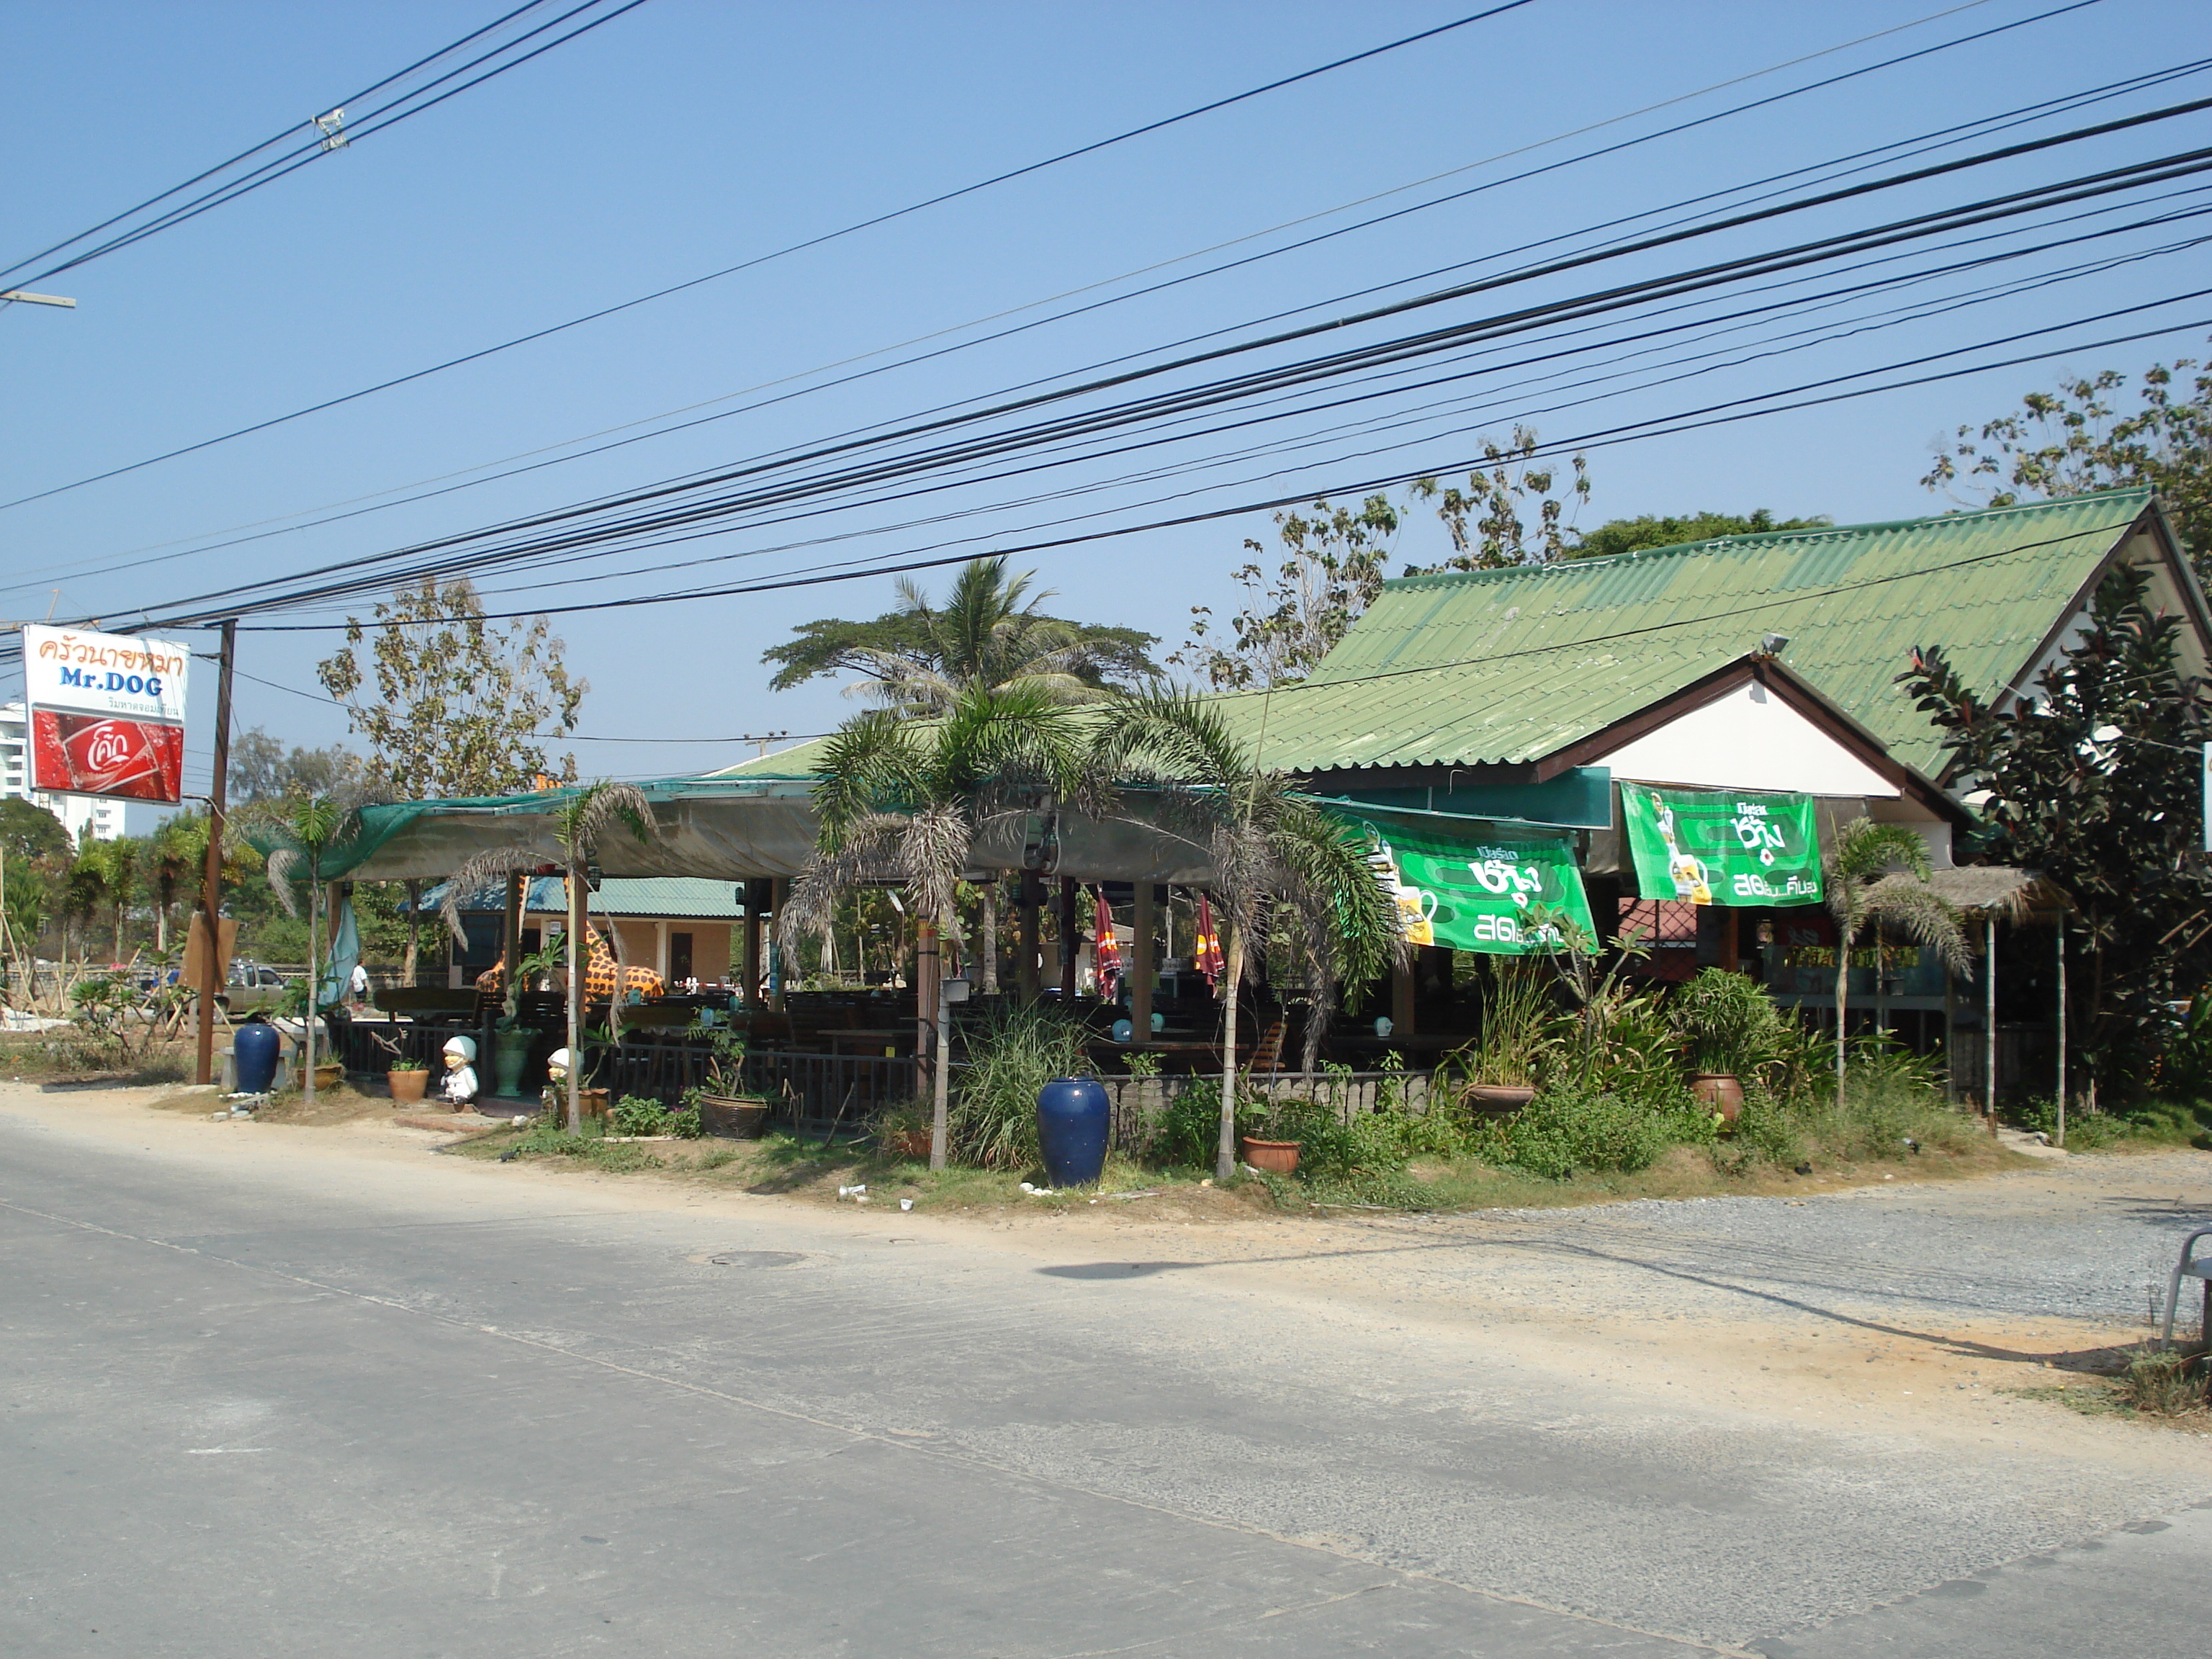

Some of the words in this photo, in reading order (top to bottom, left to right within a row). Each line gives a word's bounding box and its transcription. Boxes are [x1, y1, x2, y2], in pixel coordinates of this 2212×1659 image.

[40, 634, 184, 677] ครัวนายหมา
[59, 666, 163, 696] Mr.DOG
